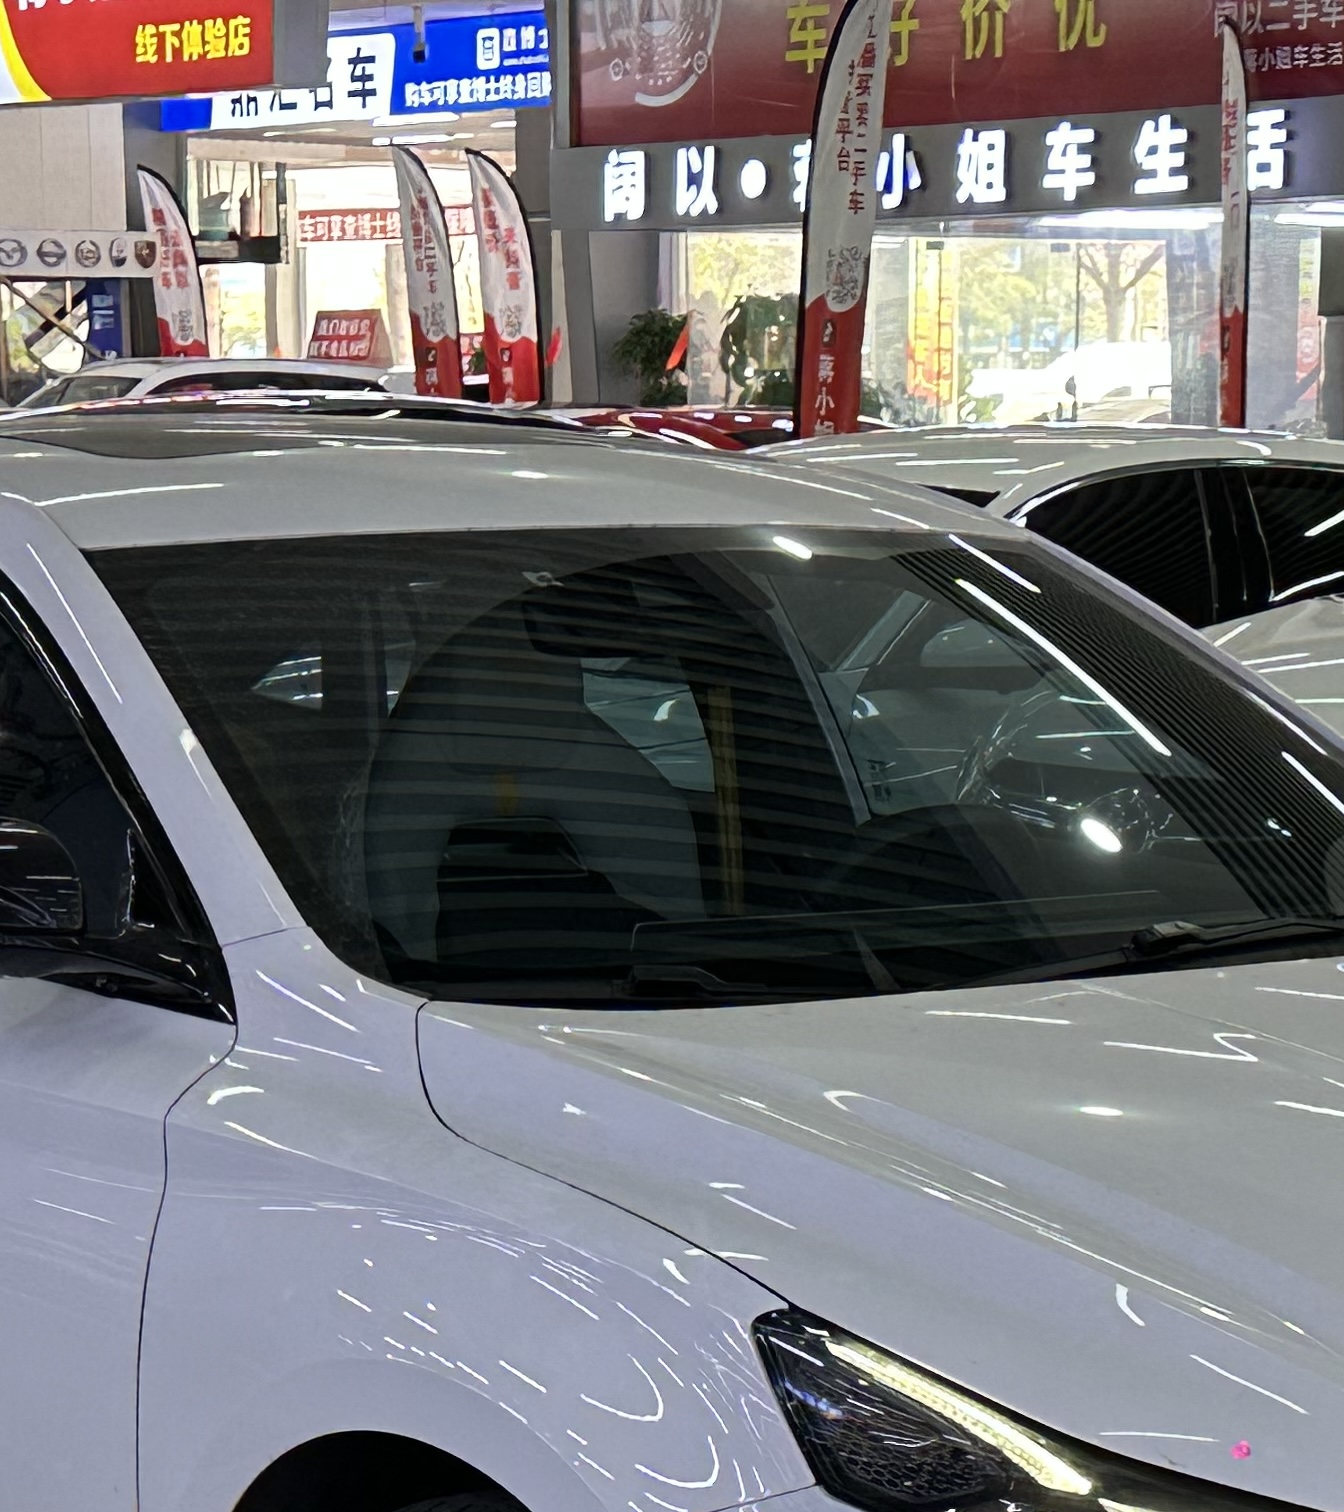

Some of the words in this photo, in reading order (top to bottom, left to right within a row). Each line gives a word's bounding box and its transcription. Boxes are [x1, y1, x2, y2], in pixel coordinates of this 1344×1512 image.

[134, 16, 251, 64] 线下体验店
